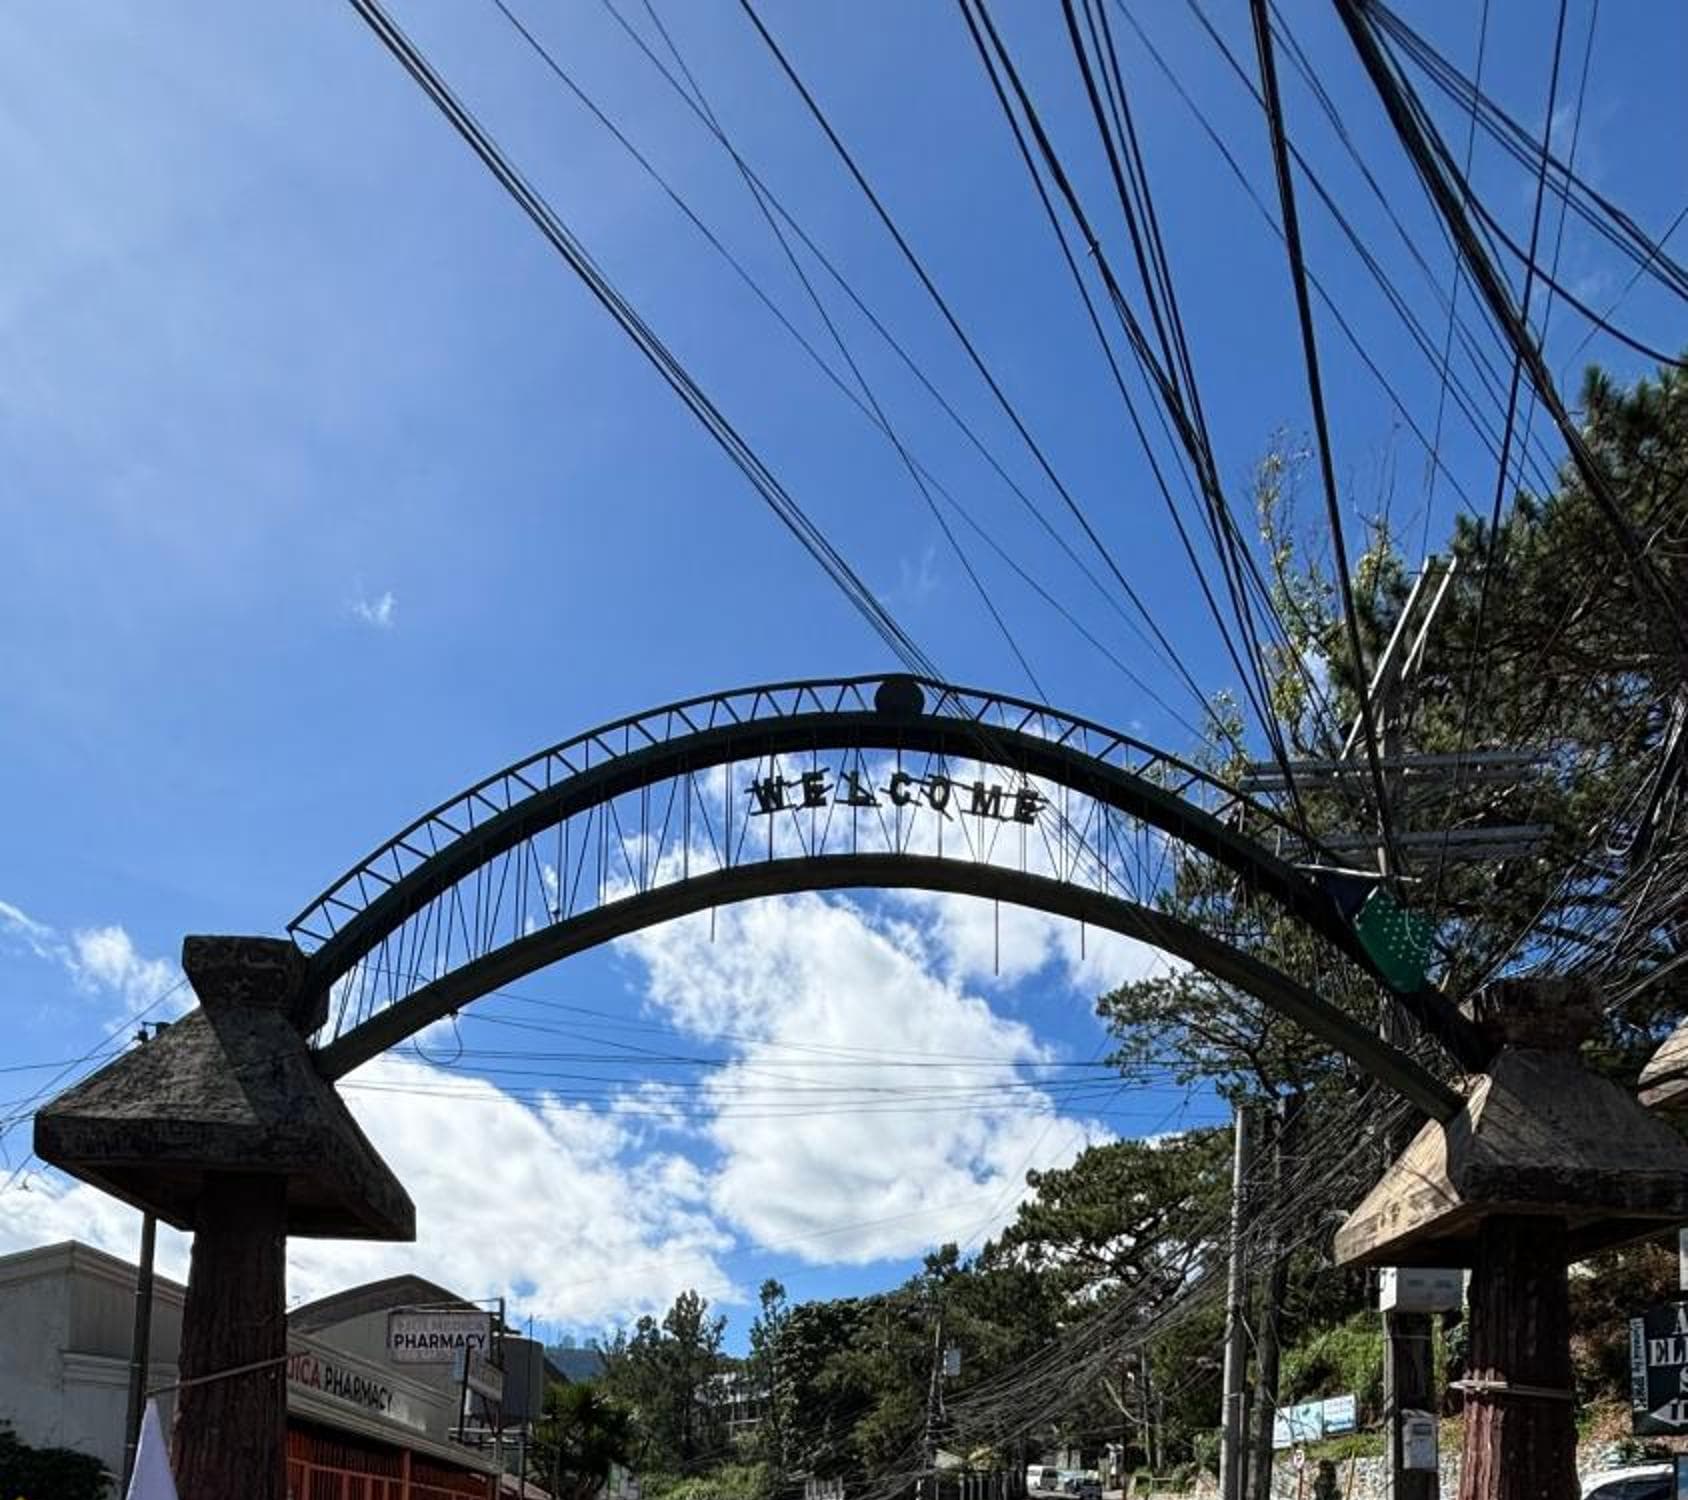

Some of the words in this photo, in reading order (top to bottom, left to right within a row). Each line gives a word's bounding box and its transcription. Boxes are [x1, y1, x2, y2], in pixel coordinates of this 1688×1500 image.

[747, 769, 1043, 824] WELCOME
[393, 1332, 486, 1349] PHARMACY
[1648, 1336, 1688, 1367] EL
[324, 1365, 393, 1413] PHARMACY
